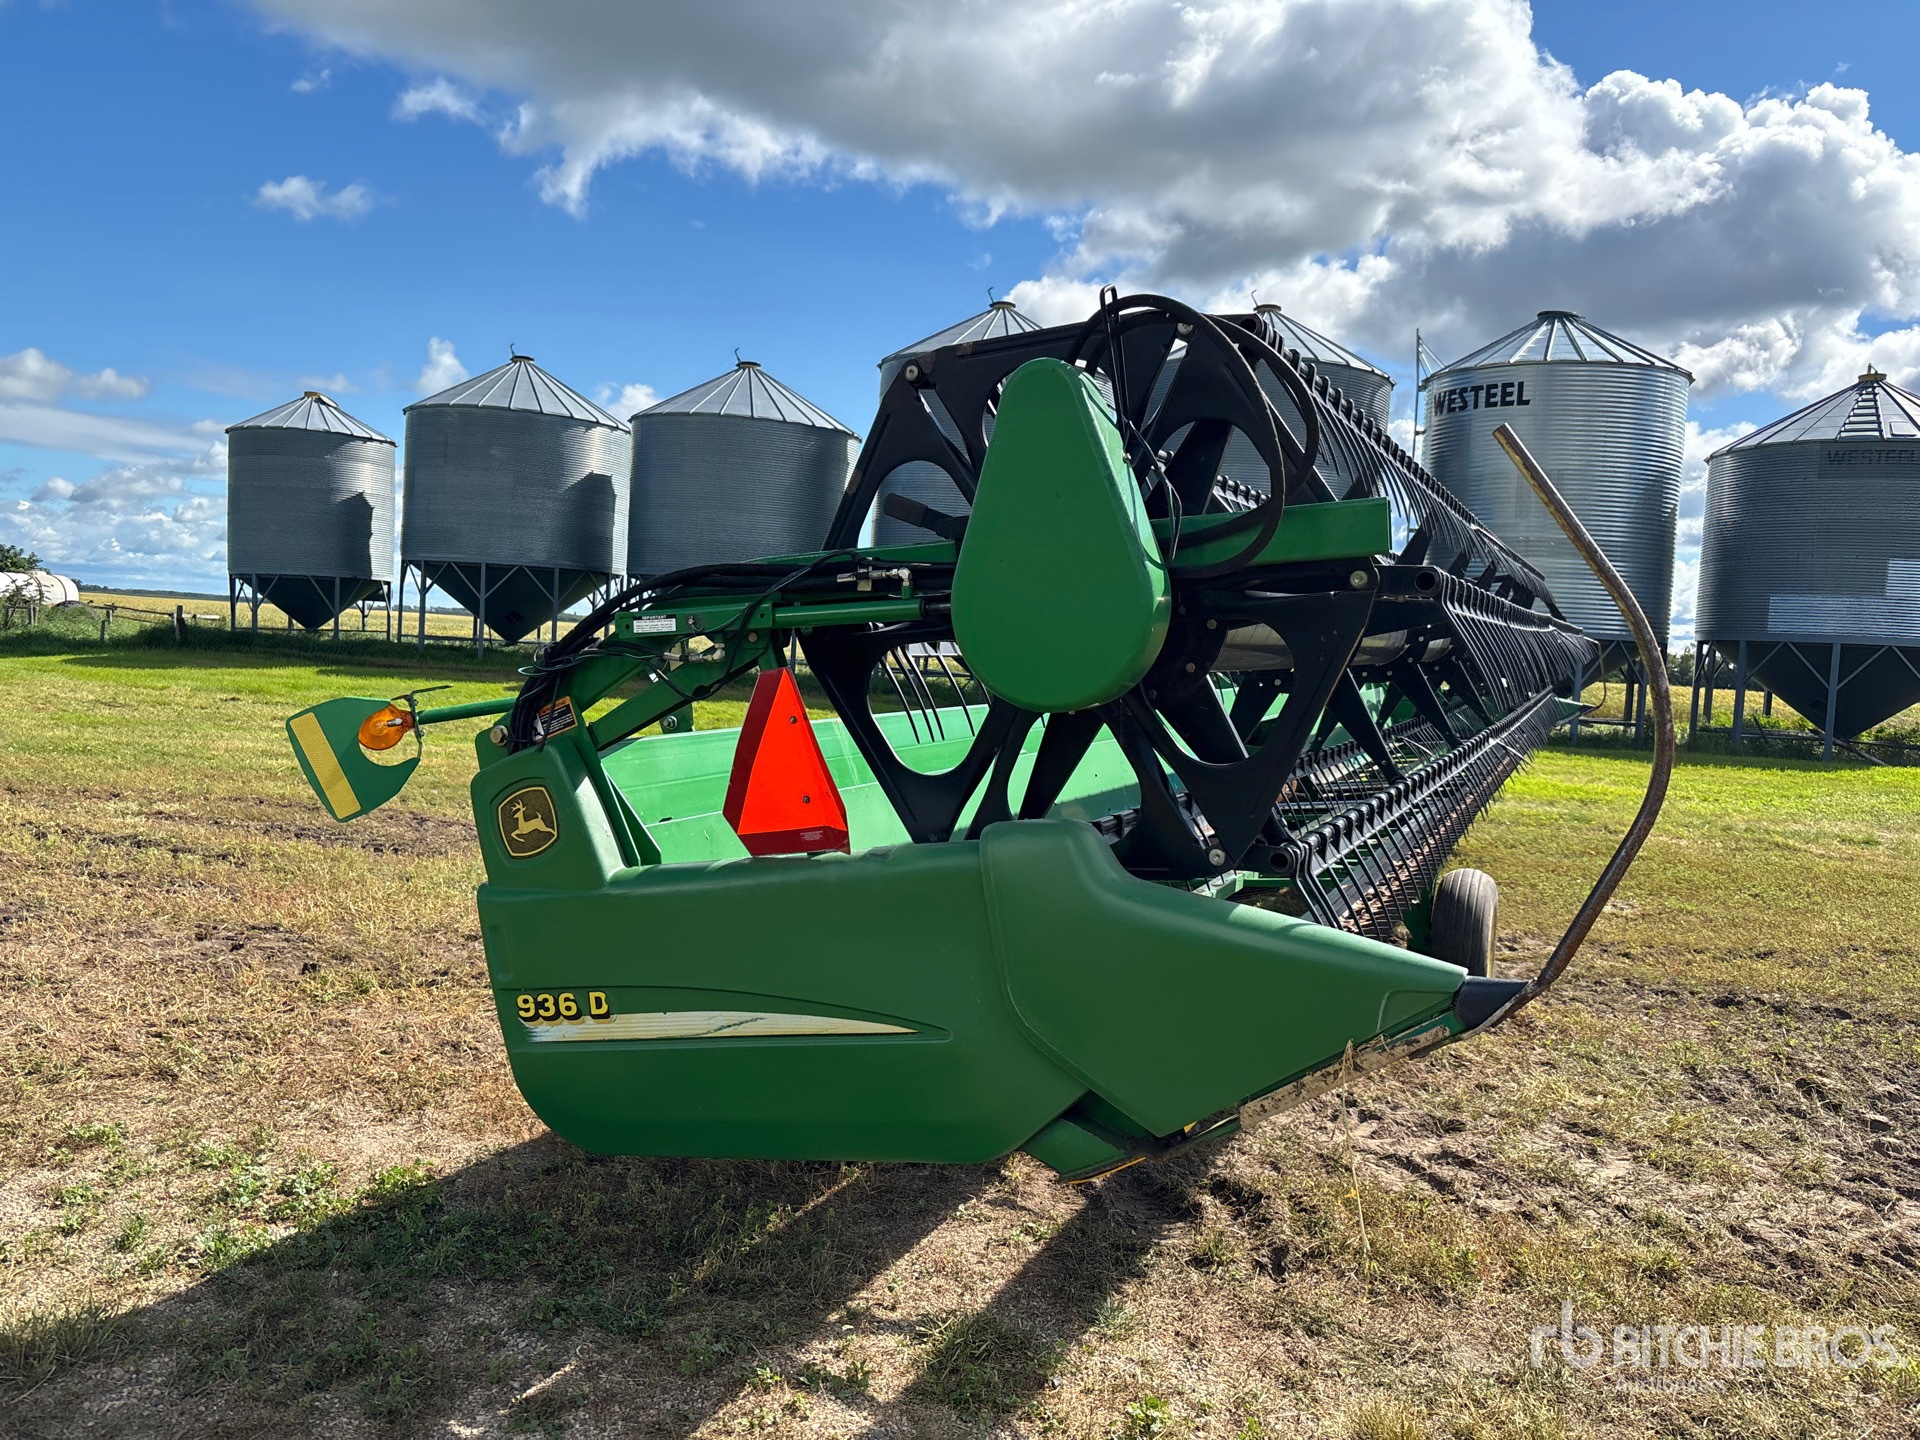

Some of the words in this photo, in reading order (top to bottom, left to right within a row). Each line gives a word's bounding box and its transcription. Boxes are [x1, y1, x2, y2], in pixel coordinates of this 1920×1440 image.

[1433, 381, 1531, 416] WESTEEL
[516, 992, 583, 1022] 936
[588, 990, 611, 1019] D
